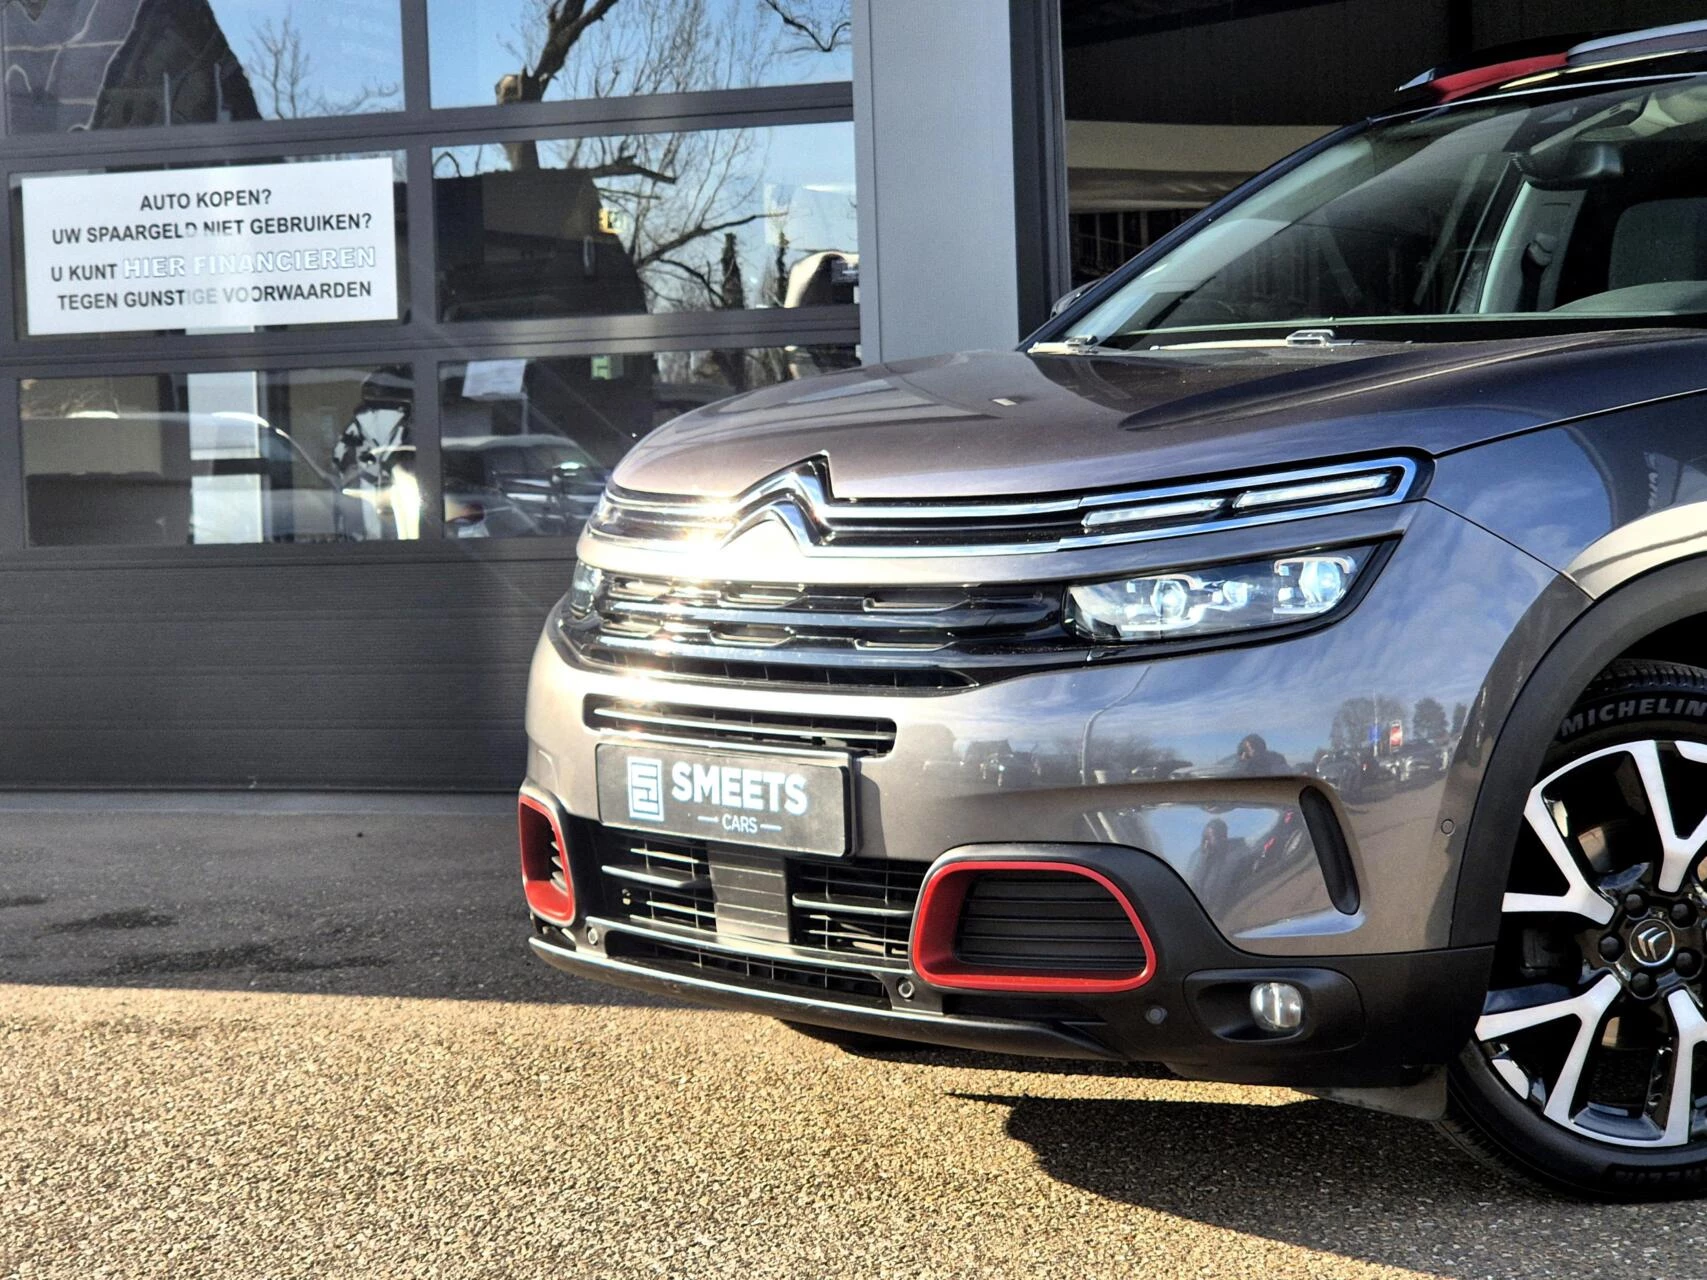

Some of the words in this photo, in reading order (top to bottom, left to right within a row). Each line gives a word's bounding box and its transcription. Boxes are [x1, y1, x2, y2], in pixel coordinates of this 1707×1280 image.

[140, 193, 192, 212] AUTO
[197, 188, 272, 209] KOPEN?
[52, 227, 82, 245] UW
[86, 221, 198, 243] SPAARGELD
[203, 219, 244, 237] NIET
[250, 212, 372, 235] GEBRUIKEN?
[51, 266, 63, 282] U
[69, 262, 118, 281] KUNT
[123, 255, 186, 279] HIER
[193, 246, 376, 276] FINANCIEREN
[58, 292, 118, 311] TEGEN
[124, 286, 218, 308] GUNSTIGE
[223, 280, 372, 304] VOORWAARDEN
[1560, 697, 1707, 737] MICHELIN
[671, 760, 809, 816] SMEETS
[721, 813, 758, 834] CARS
